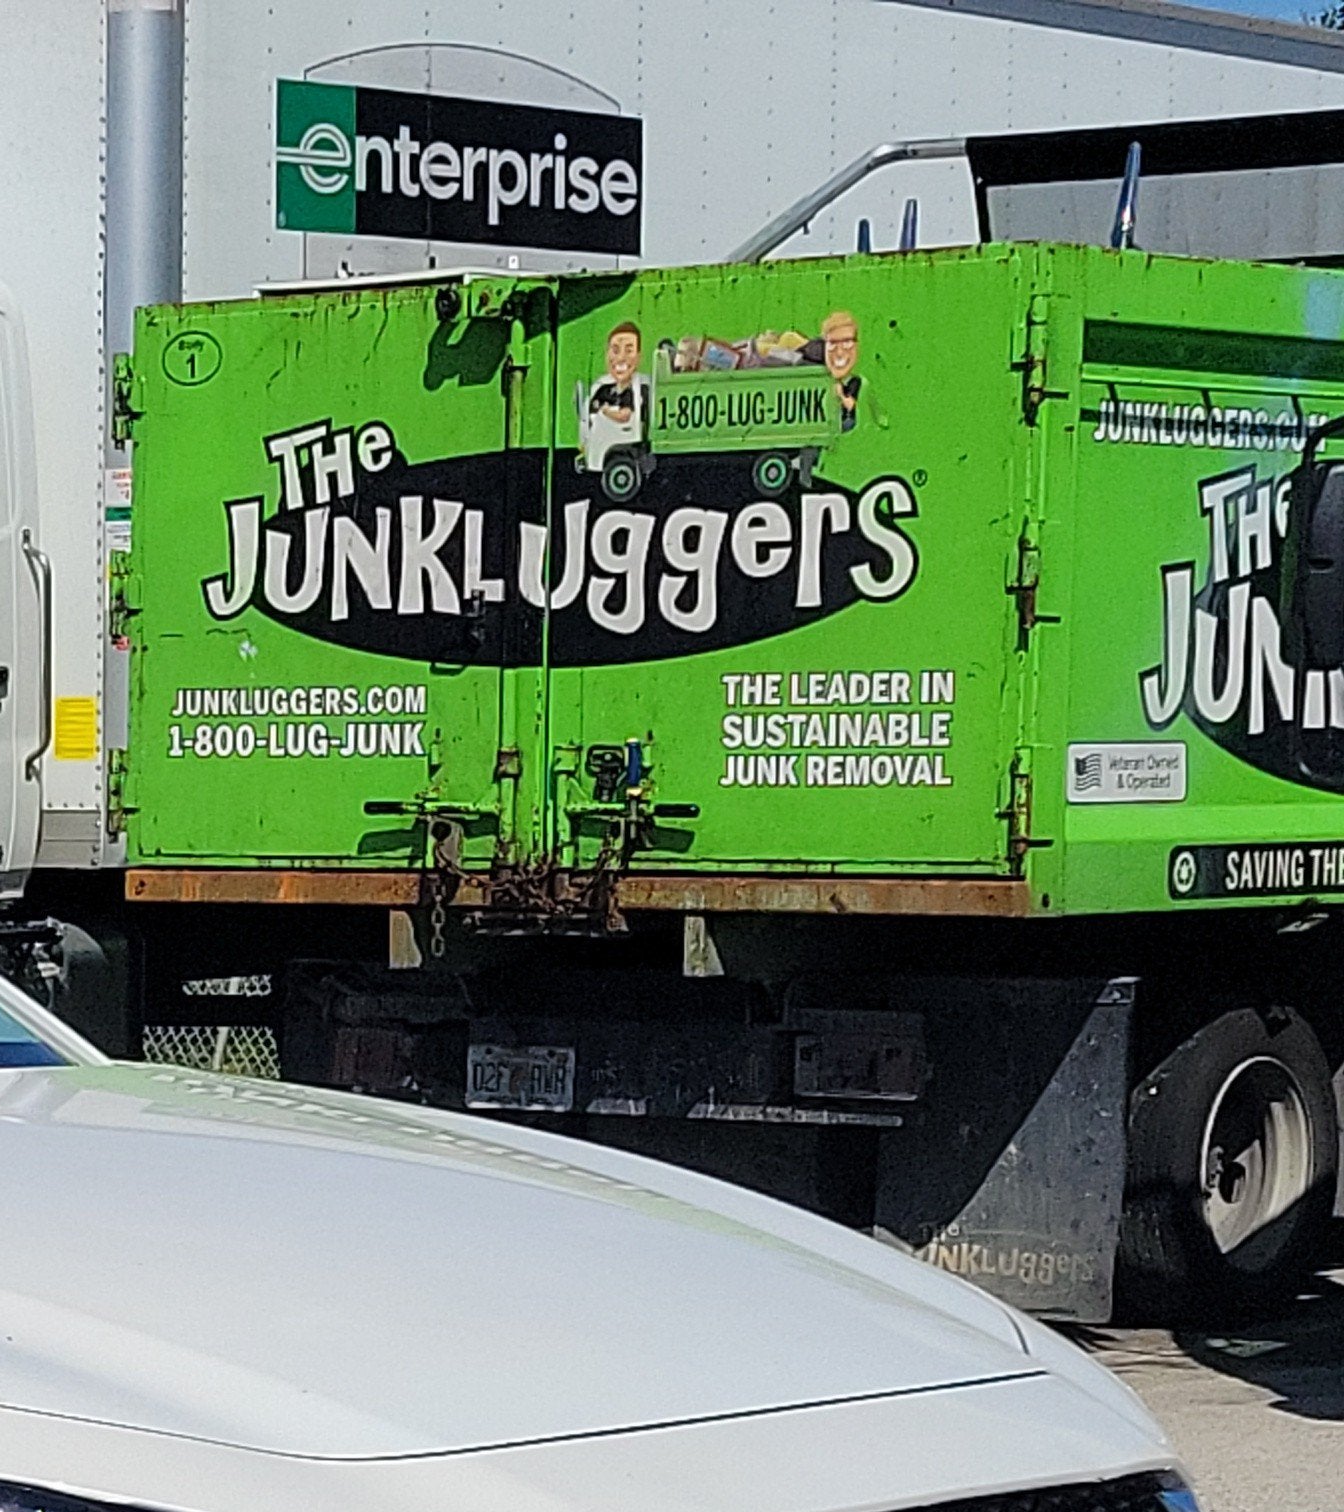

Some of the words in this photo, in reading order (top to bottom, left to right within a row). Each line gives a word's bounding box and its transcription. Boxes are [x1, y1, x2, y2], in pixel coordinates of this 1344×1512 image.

[277, 123, 638, 226] enterprise
[186, 353, 196, 379] 1
[657, 388, 827, 430] 1-800-LUG-JUNK
[171, 685, 427, 716] JUNKLUGGERS.COM
[721, 673, 782, 706] THE
[789, 671, 911, 705] LEADER
[919, 670, 955, 704] IN
[167, 722, 425, 758] 1-800-LUG-JUNK
[721, 711, 952, 748] SUSTAINABLE
[718, 753, 799, 786] JUNK
[805, 753, 952, 786] REMOVAL
[1224, 849, 1305, 891] SAVING
